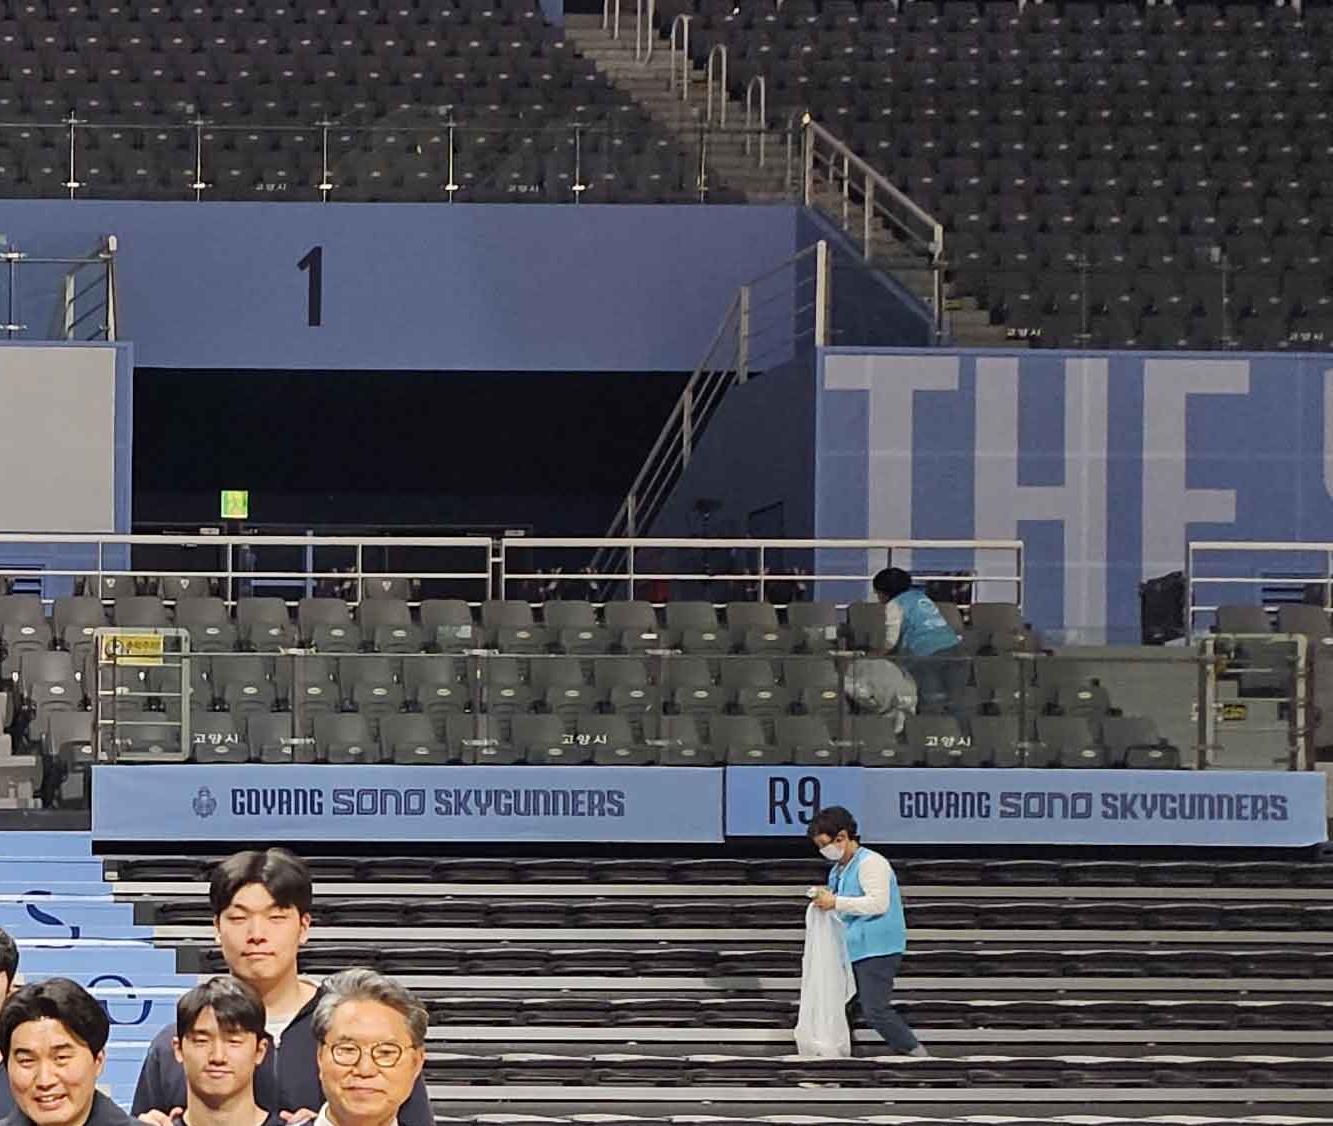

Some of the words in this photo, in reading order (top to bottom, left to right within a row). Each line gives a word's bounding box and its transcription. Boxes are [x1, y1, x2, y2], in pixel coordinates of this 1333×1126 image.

[297, 246, 323, 327] 1
[824, 356, 1250, 645] THE
[193, 733, 239, 745] 고양시
[561, 733, 608, 746] 고양시
[924, 735, 971, 747] 고양시
[232, 788, 324, 815] GOYANG
[434, 789, 626, 817] SKYGUNNERS
[769, 776, 821, 825] R9
[899, 791, 991, 819] GOYANG
[1101, 793, 1289, 822] SKYGUNNERS
